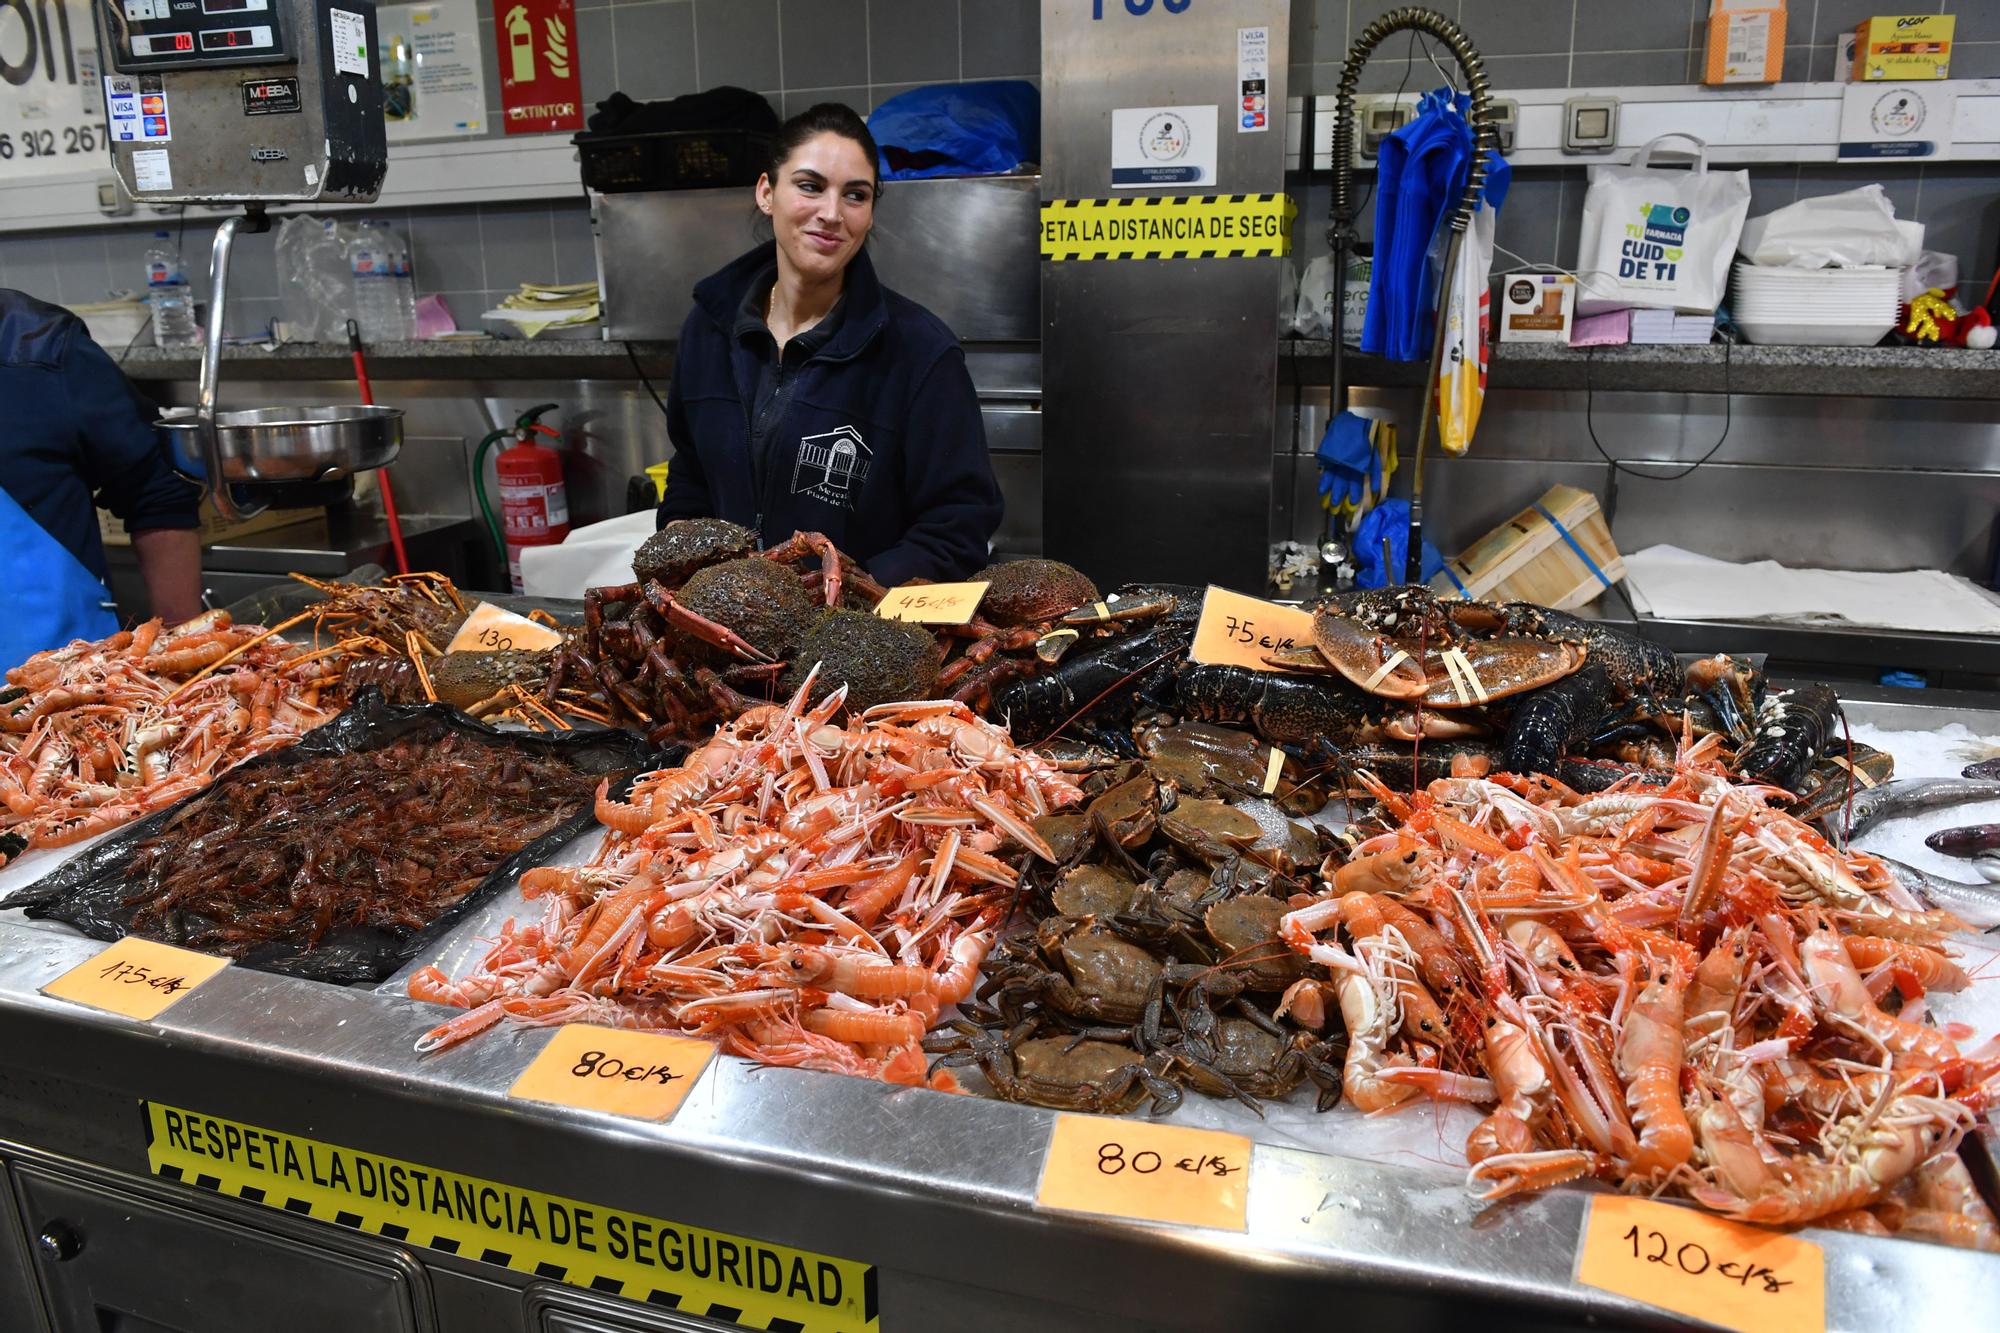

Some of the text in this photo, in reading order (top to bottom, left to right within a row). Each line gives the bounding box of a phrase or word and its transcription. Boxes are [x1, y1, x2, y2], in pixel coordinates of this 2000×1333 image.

[112, 80, 132, 91] VISA
[114, 102, 134, 112] VISA
[510, 103, 575, 120] EXTINTOR
[21, 128, 56, 158] 312
[64, 123, 106, 154] 267
[1083, 219, 1104, 241] LA
[1109, 217, 1205, 240] DISTANCIA
[1210, 216, 1234, 238] DE
[1625, 224, 1682, 242] TU FARMACIA
[1619, 258, 1676, 281] DE TI
[479, 628, 513, 650] 130
[164, 1109, 843, 1307] RESPETA LA DISTANCIA DE SEGURIDAD
